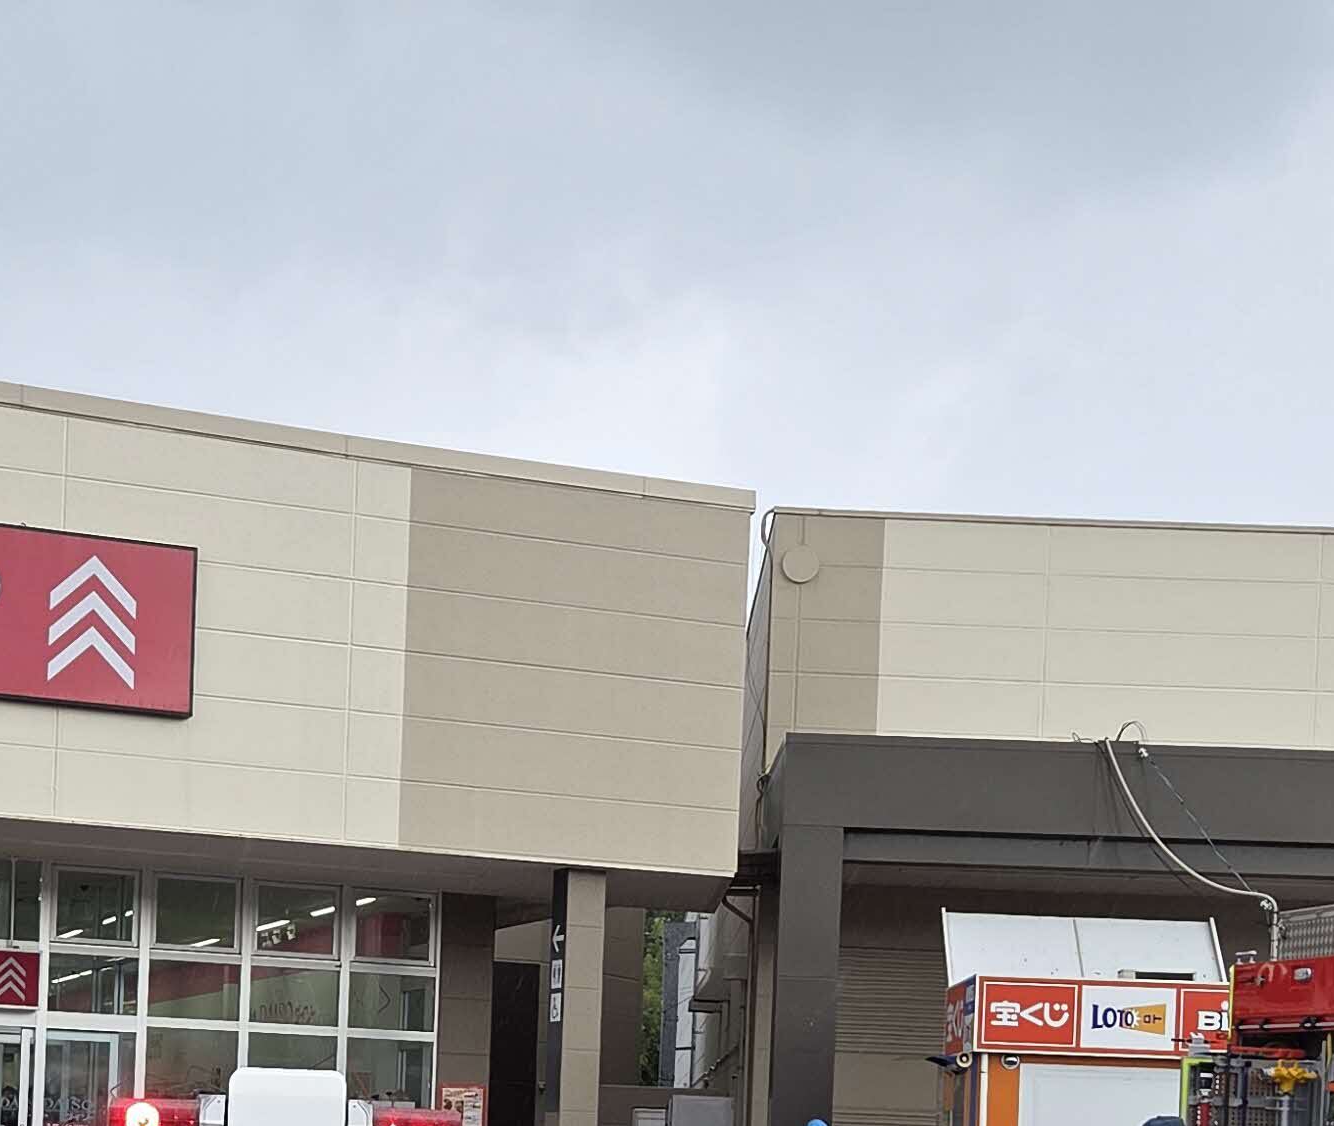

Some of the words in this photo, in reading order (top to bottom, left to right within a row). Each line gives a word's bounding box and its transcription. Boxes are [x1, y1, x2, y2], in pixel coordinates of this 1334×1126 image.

[990, 1000, 1070, 1028] 宝くじ
[1092, 1004, 1135, 1029] LOTO
[1197, 1000, 1229, 1032] Bi
